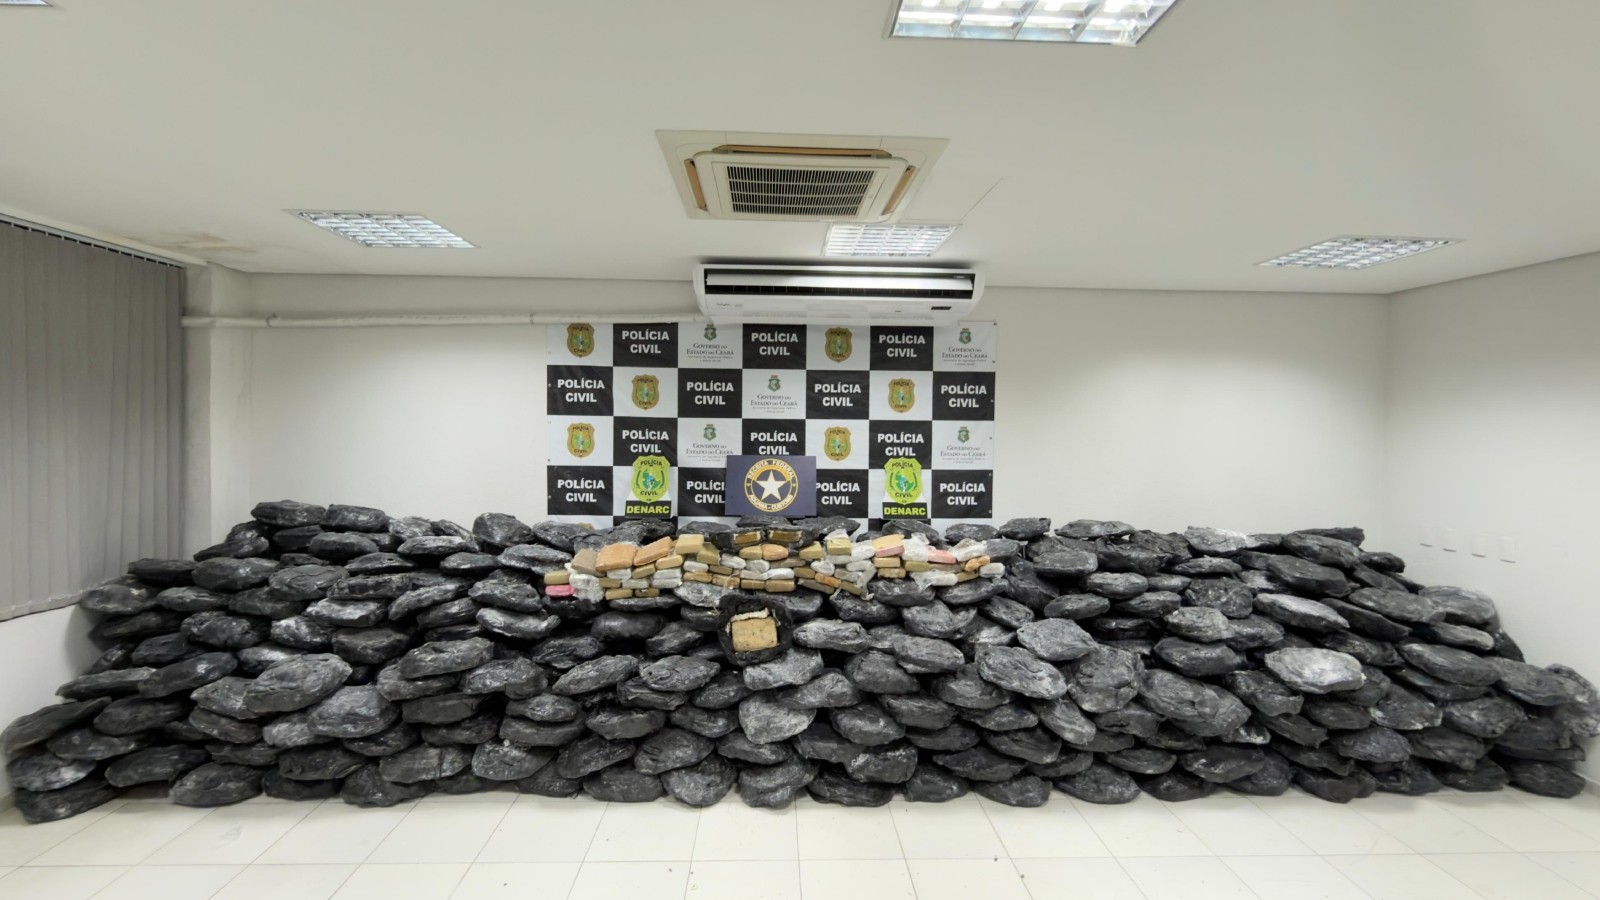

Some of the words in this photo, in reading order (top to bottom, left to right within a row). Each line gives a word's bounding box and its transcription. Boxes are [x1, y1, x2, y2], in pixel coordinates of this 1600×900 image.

[622, 328, 670, 340] POLÍCIA
[751, 331, 798, 342] POLÍCIA
[878, 332, 926, 344] POLÍCIA
[630, 344, 662, 354] CIVIL
[760, 346, 790, 356] CIVIL
[886, 348, 918, 358] CIVIL
[557, 378, 605, 389] POLÍCIA
[686, 380, 734, 392] POLÍCIA
[814, 382, 862, 394] POLÍCIA
[941, 384, 987, 394] POLÍCIA
[566, 392, 597, 402] CIVIL
[694, 395, 726, 405] CIVIL
[822, 397, 853, 406] CIVIL
[948, 398, 980, 408] CIVIL
[622, 428, 670, 440] POLÍCIA
[750, 430, 798, 442] POLÍCIA
[878, 432, 924, 444] POLÍCIA
[630, 444, 662, 454] CIVIL
[758, 446, 790, 455] CIVIL
[885, 447, 916, 456] CIVIL
[558, 478, 605, 489] POLÍCIA
[686, 480, 725, 490] POLÍCI
[940, 482, 986, 492] POLÍCIA
[566, 492, 597, 502] CIVIL
[694, 494, 726, 504] CIVIL
[821, 496, 852, 504] CIVIL
[947, 496, 978, 506] CIVIL
[626, 505, 670, 514] DENARC
[884, 507, 926, 516] DENARC
